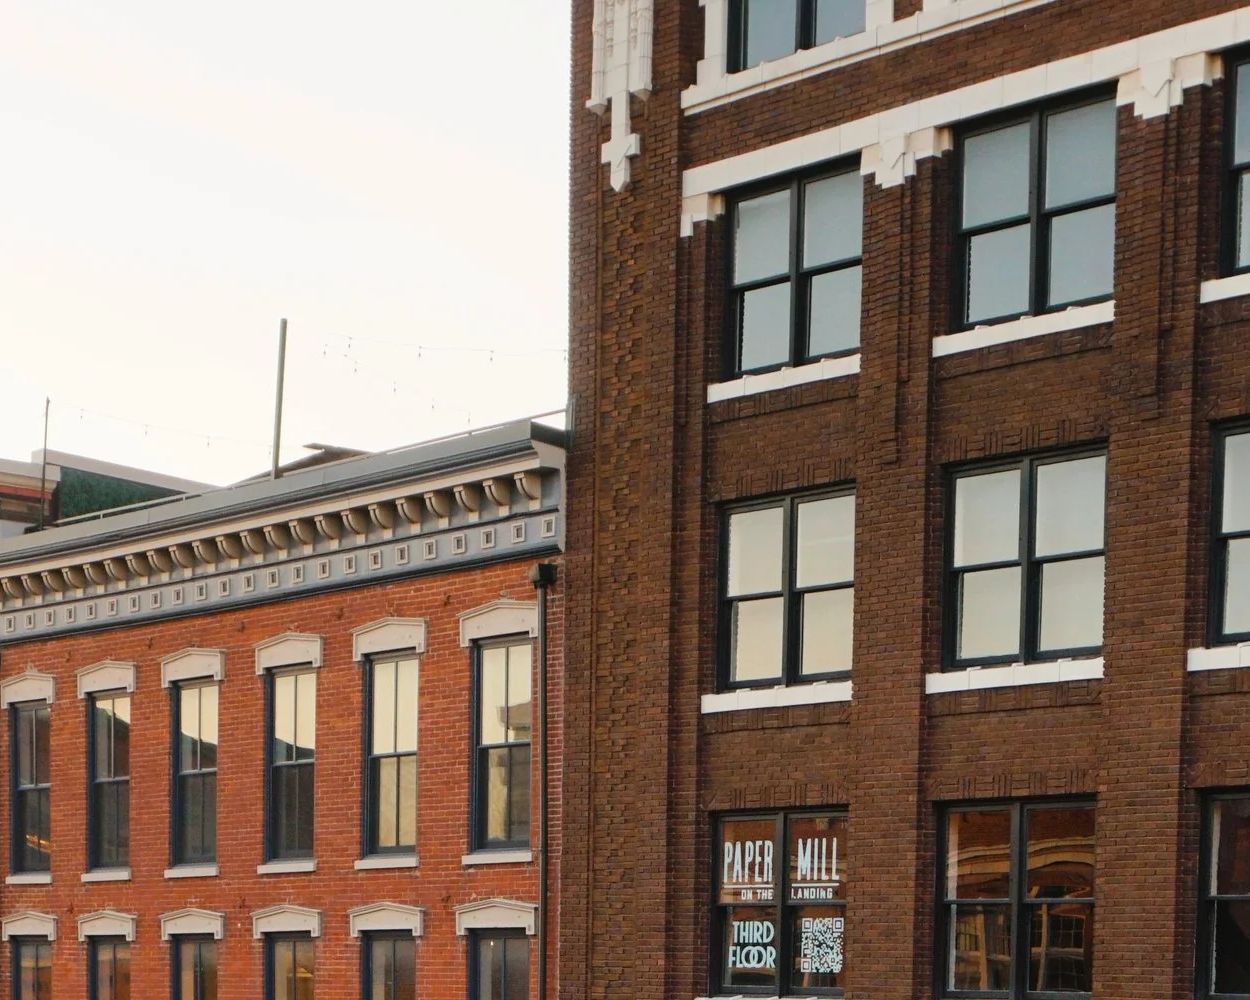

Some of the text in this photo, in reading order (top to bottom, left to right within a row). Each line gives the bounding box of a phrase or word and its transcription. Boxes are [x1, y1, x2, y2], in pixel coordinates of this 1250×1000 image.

[723, 837, 840, 883] PAPER MILL
[741, 888, 833, 900] ON THE LANDING
[732, 920, 775, 944] THIRD
[728, 945, 776, 968] FLOOR
